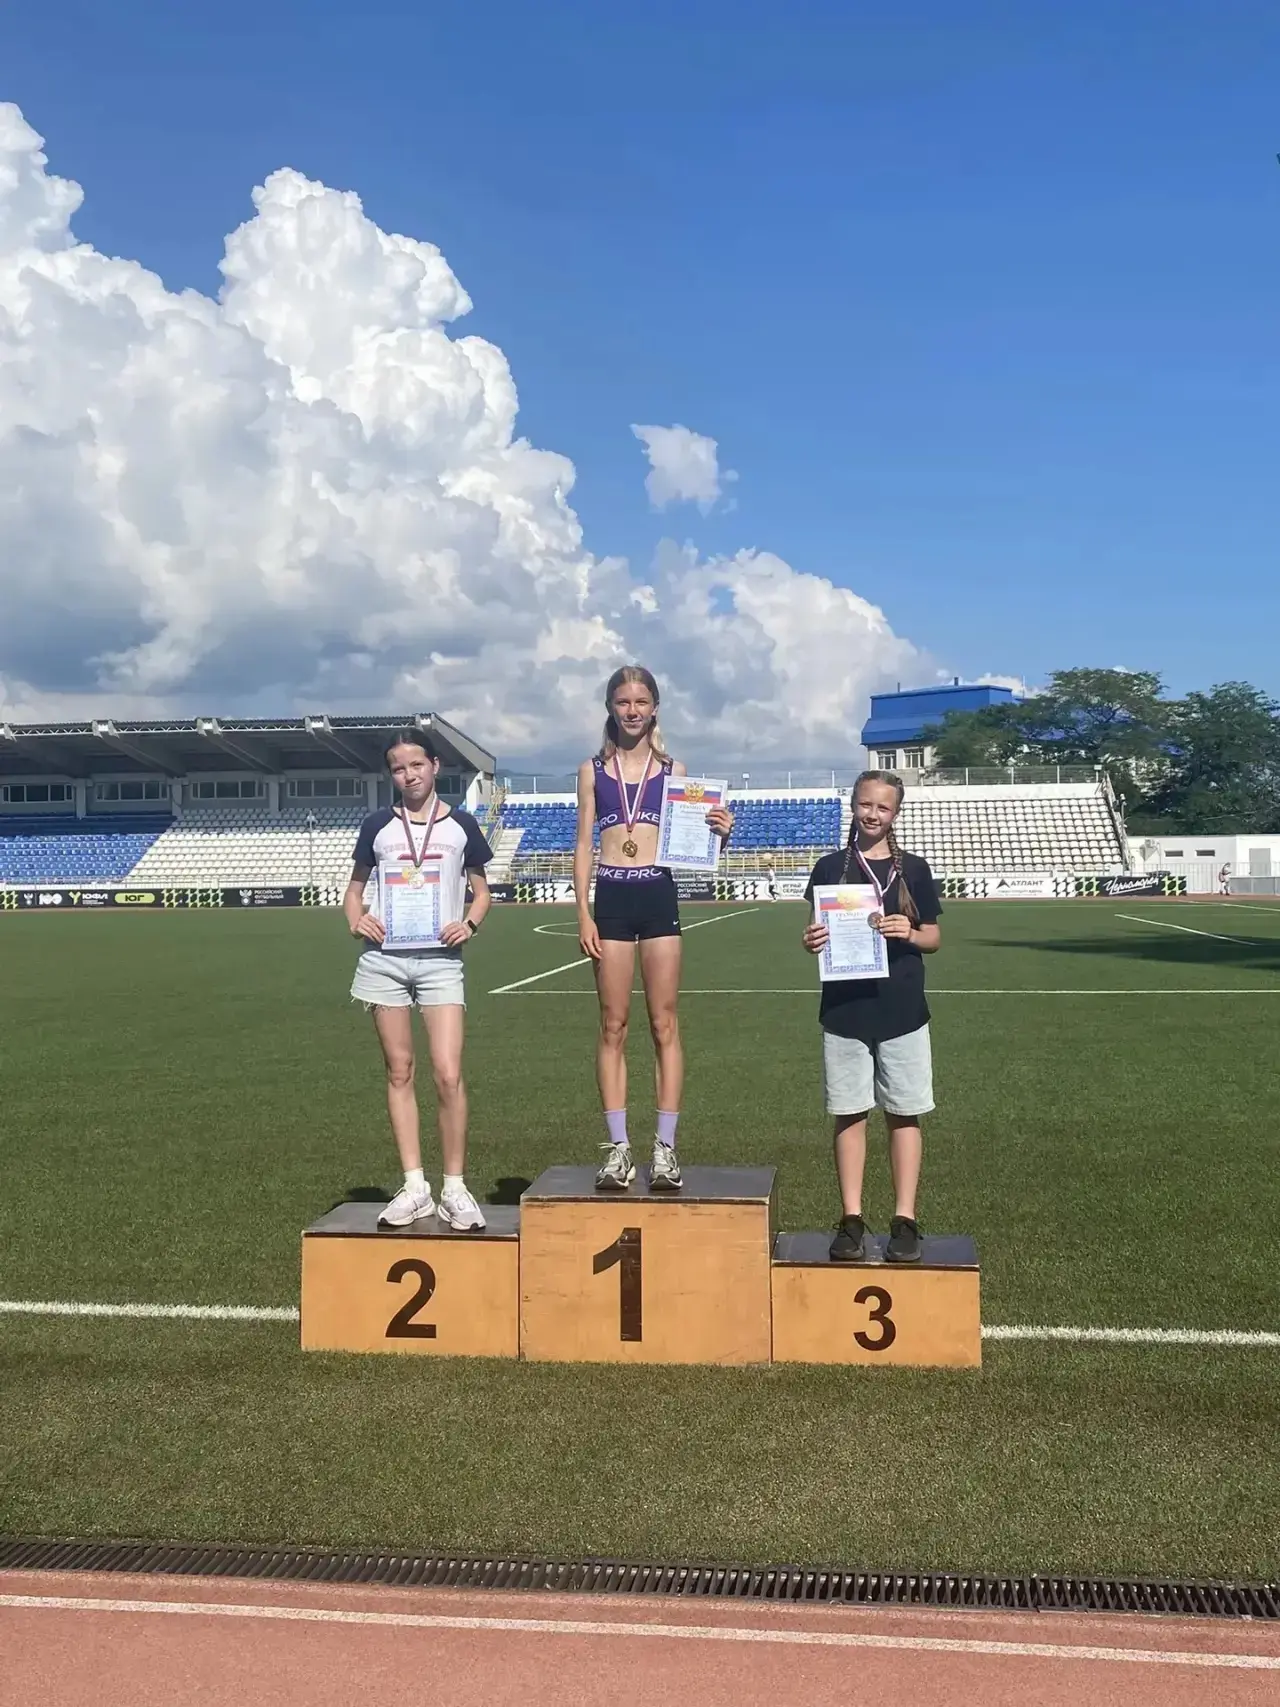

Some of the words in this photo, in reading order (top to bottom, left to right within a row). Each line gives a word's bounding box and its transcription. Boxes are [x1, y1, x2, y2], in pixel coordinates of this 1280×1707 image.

[636, 811, 660, 822] IKE
[385, 1258, 437, 1339] 2
[593, 1227, 642, 1342] 1
[853, 1285, 896, 1351] 3
